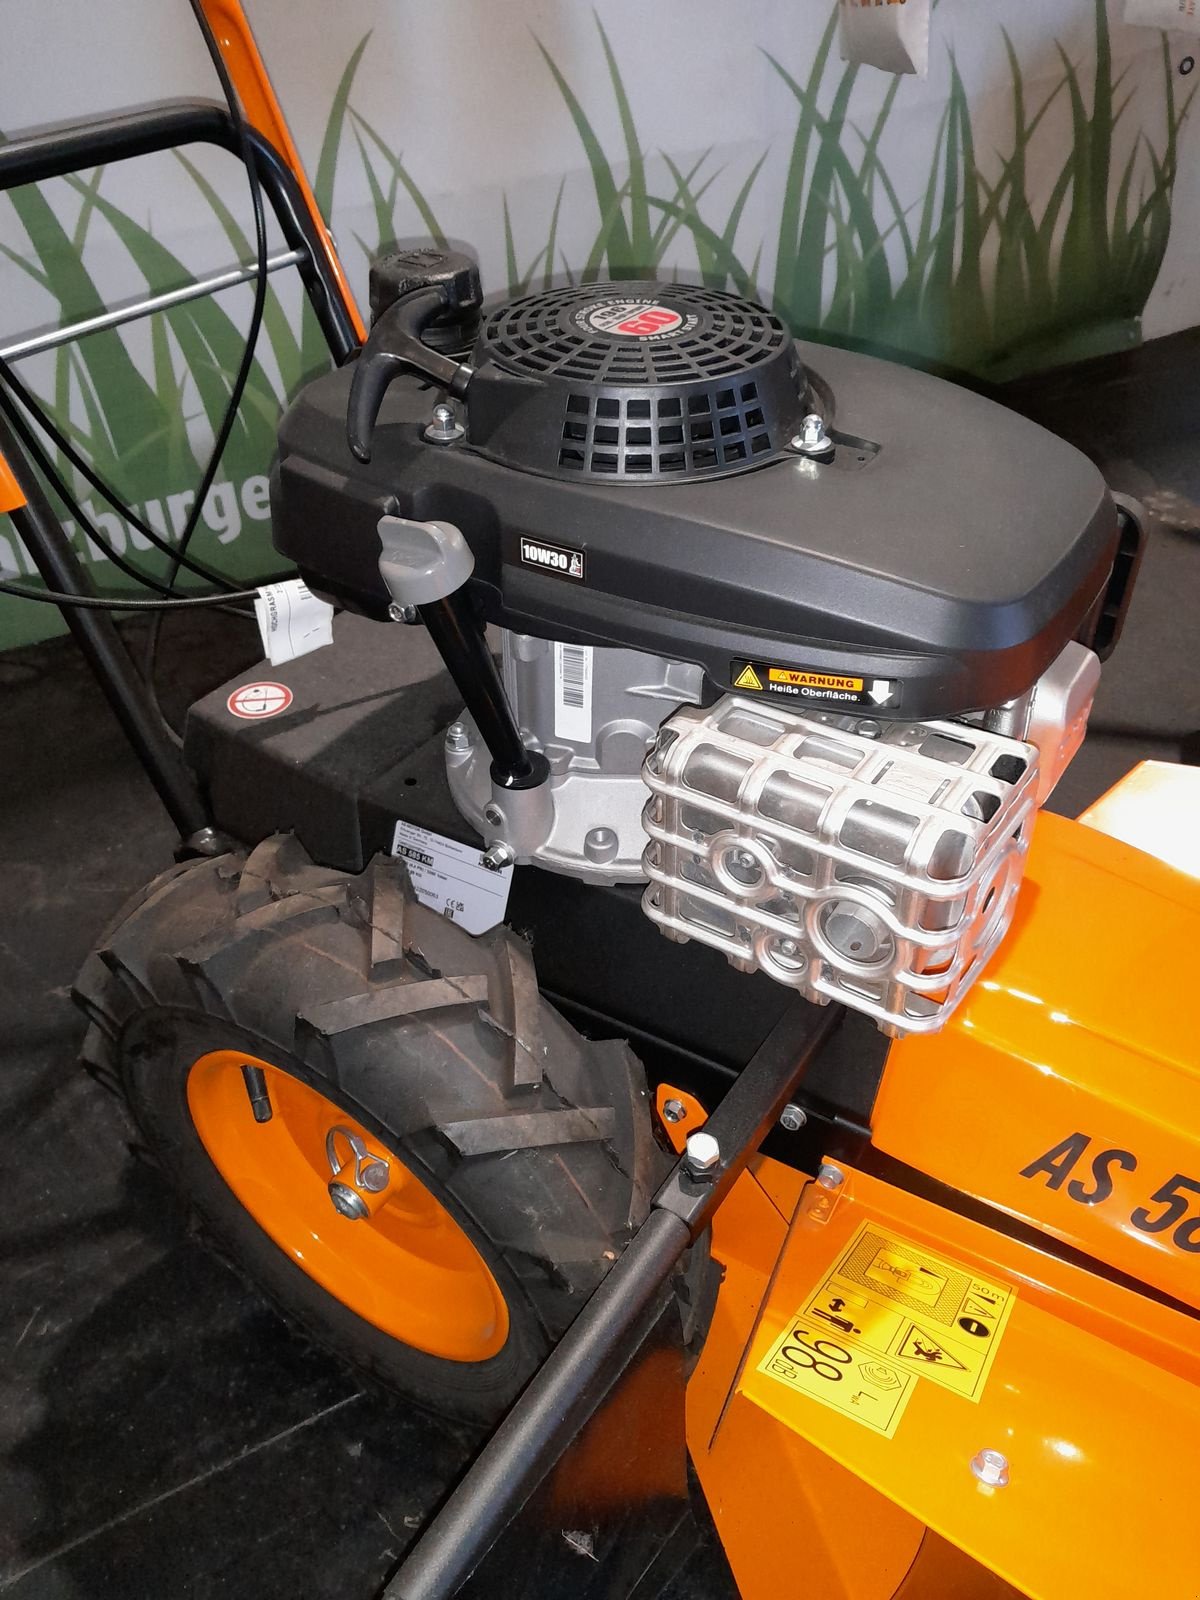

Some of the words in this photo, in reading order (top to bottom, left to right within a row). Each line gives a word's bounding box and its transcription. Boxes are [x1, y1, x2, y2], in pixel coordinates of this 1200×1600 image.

[618, 311, 679, 335] 60
[639, 329, 684, 342] SMART
[523, 544, 568, 569] 10W30
[789, 673, 855, 688] WARNUNG
[769, 683, 799, 695] Heiße
[801, 687, 861, 702] Oberfläche.
[1018, 1132, 1138, 1205] AS
[972, 1283, 990, 1294] 50
[991, 1292, 1005, 1302] m
[782, 1329, 853, 1382] 98
